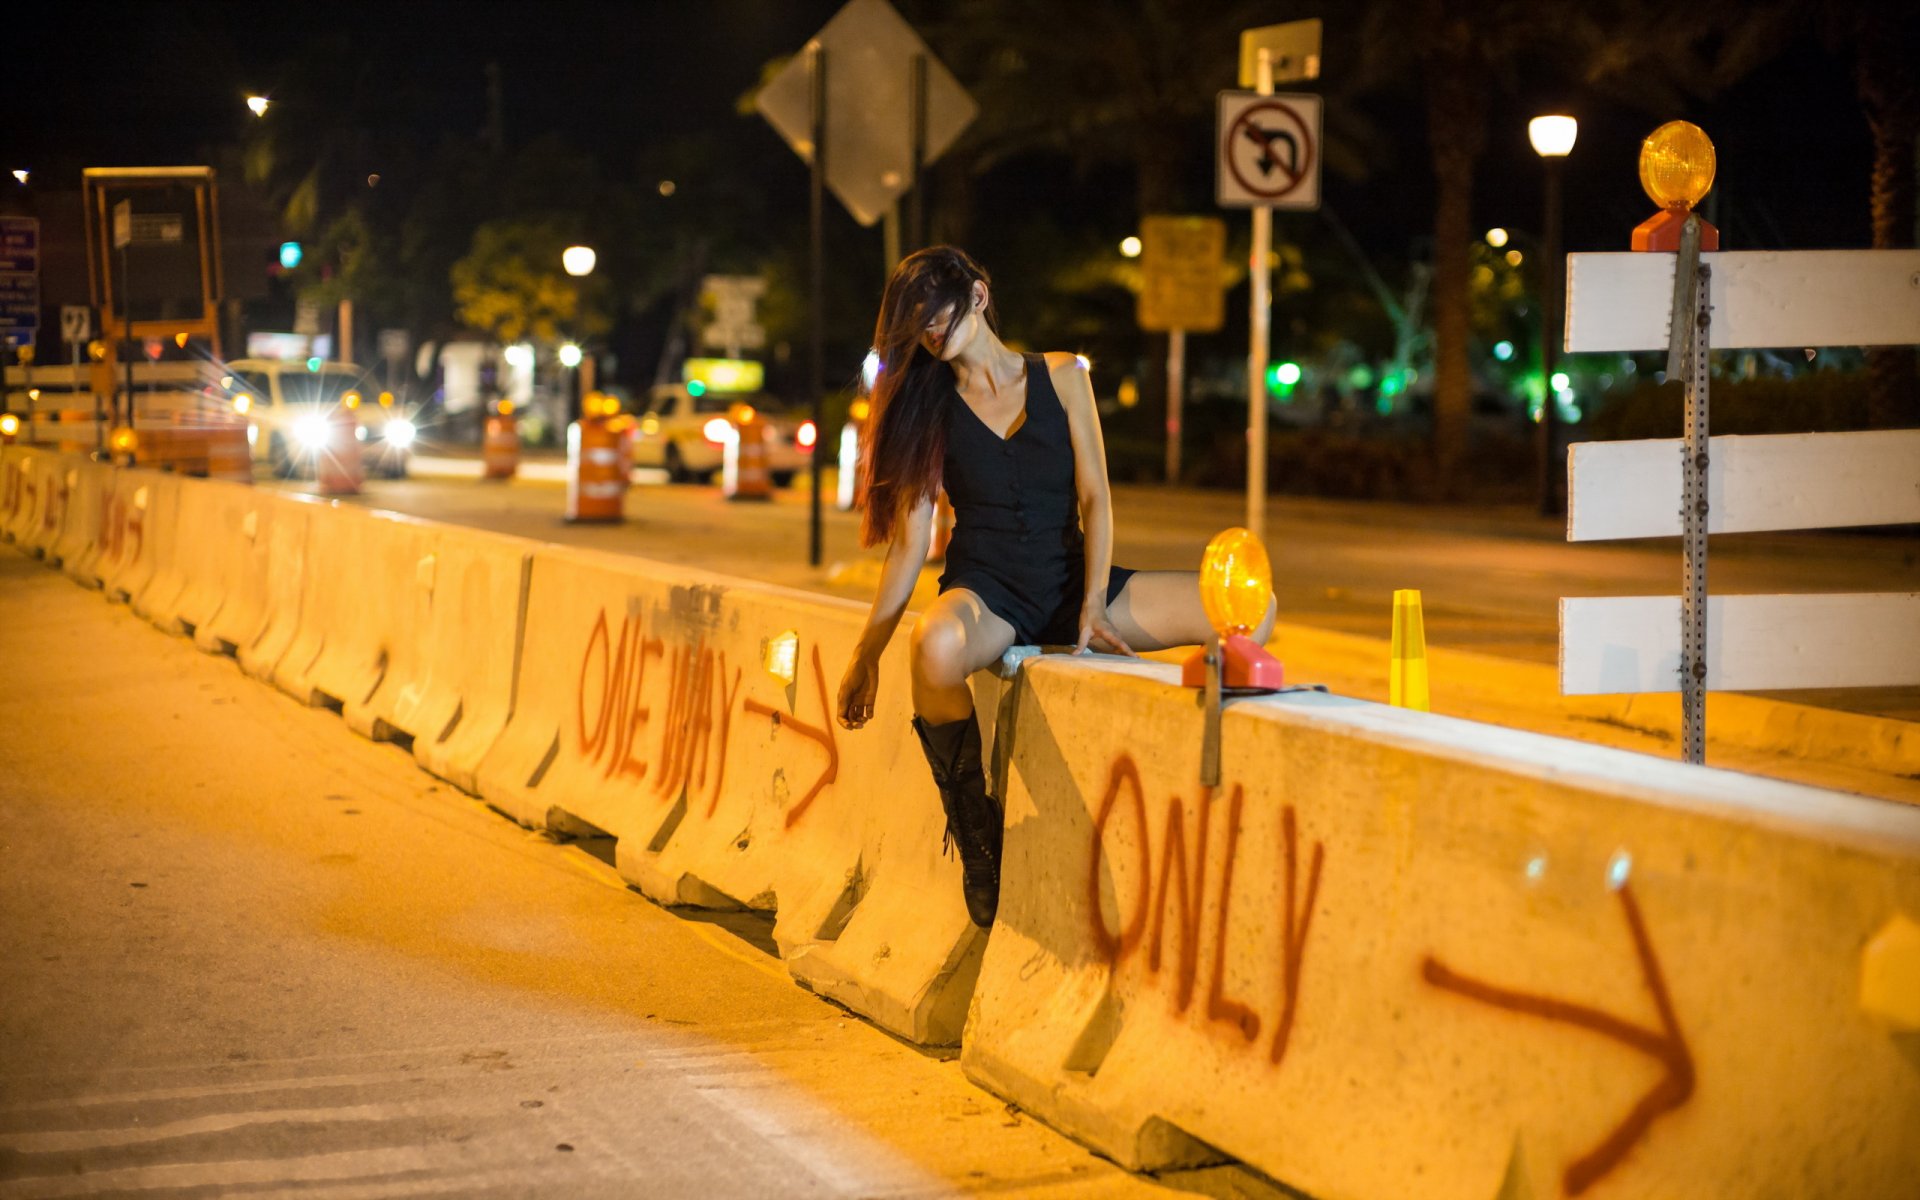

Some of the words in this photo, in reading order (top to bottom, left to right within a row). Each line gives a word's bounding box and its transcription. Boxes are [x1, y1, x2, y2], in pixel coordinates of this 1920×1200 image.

[578, 606, 664, 780] ONE
[654, 641, 743, 820] WAY
[1089, 752, 1325, 1067] ONLY
